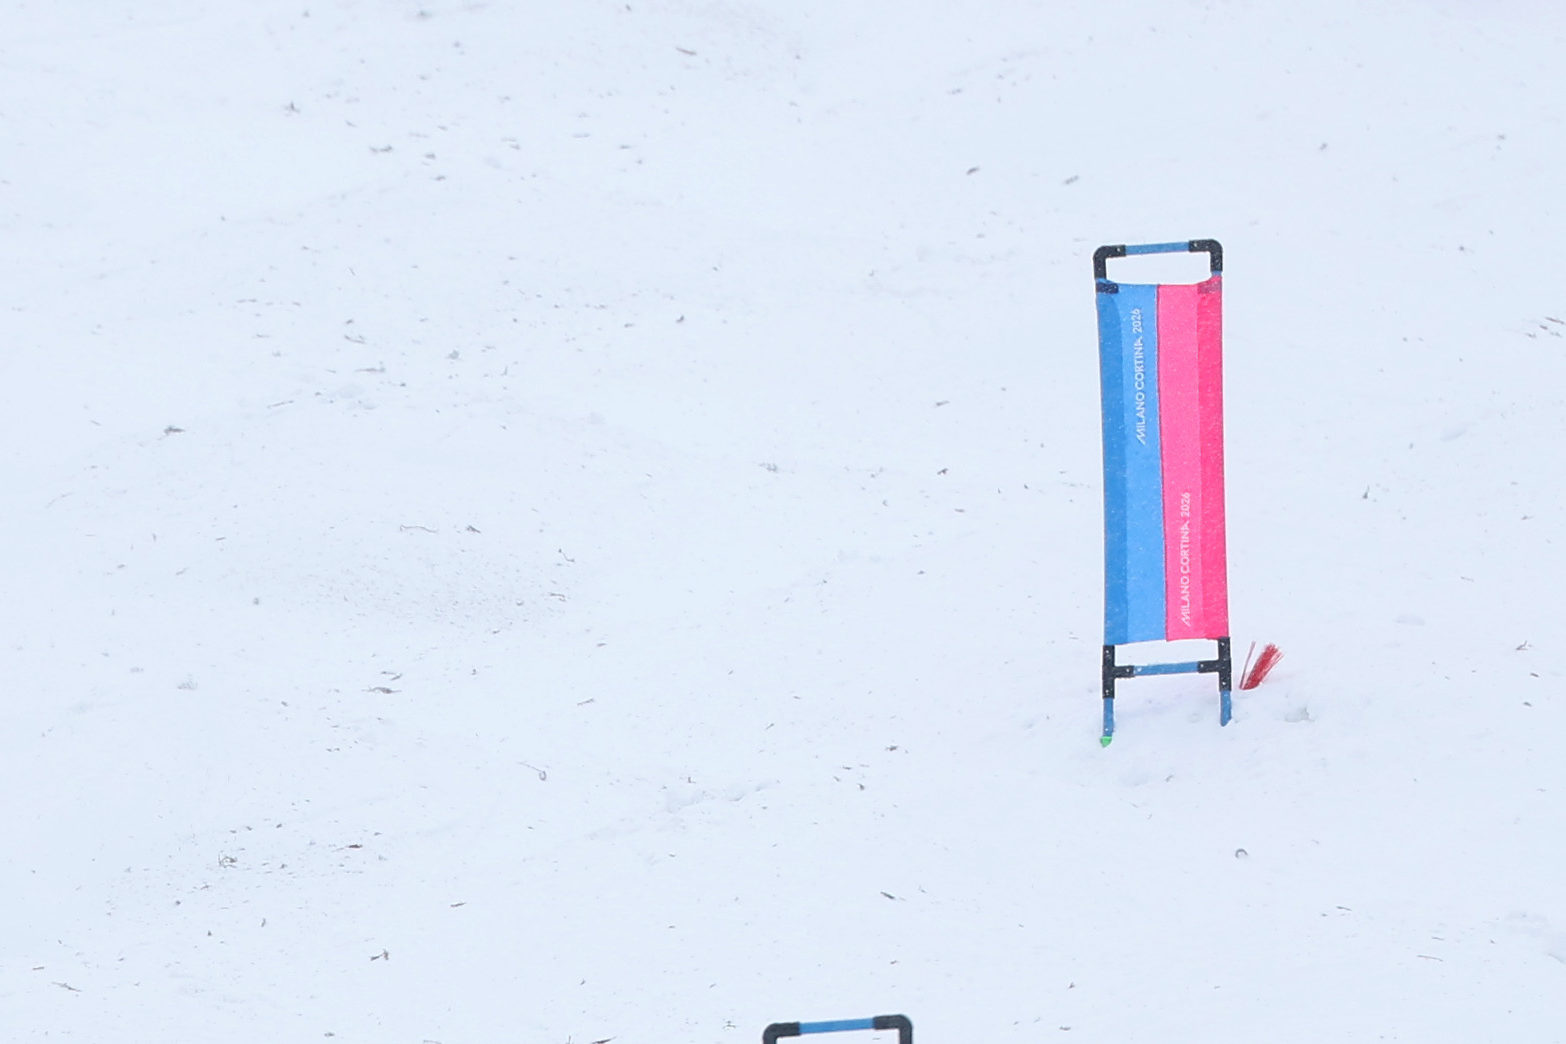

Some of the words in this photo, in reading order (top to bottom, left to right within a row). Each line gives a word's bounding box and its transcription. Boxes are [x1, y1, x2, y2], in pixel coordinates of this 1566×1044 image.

[1132, 308, 1143, 333] 2026
[1134, 336, 1145, 390] CORTINA
[1135, 392, 1146, 445] MILANO
[1180, 492, 1190, 517] 2026
[1180, 521, 1190, 574] CORTINA
[1180, 576, 1190, 627] MILANO
